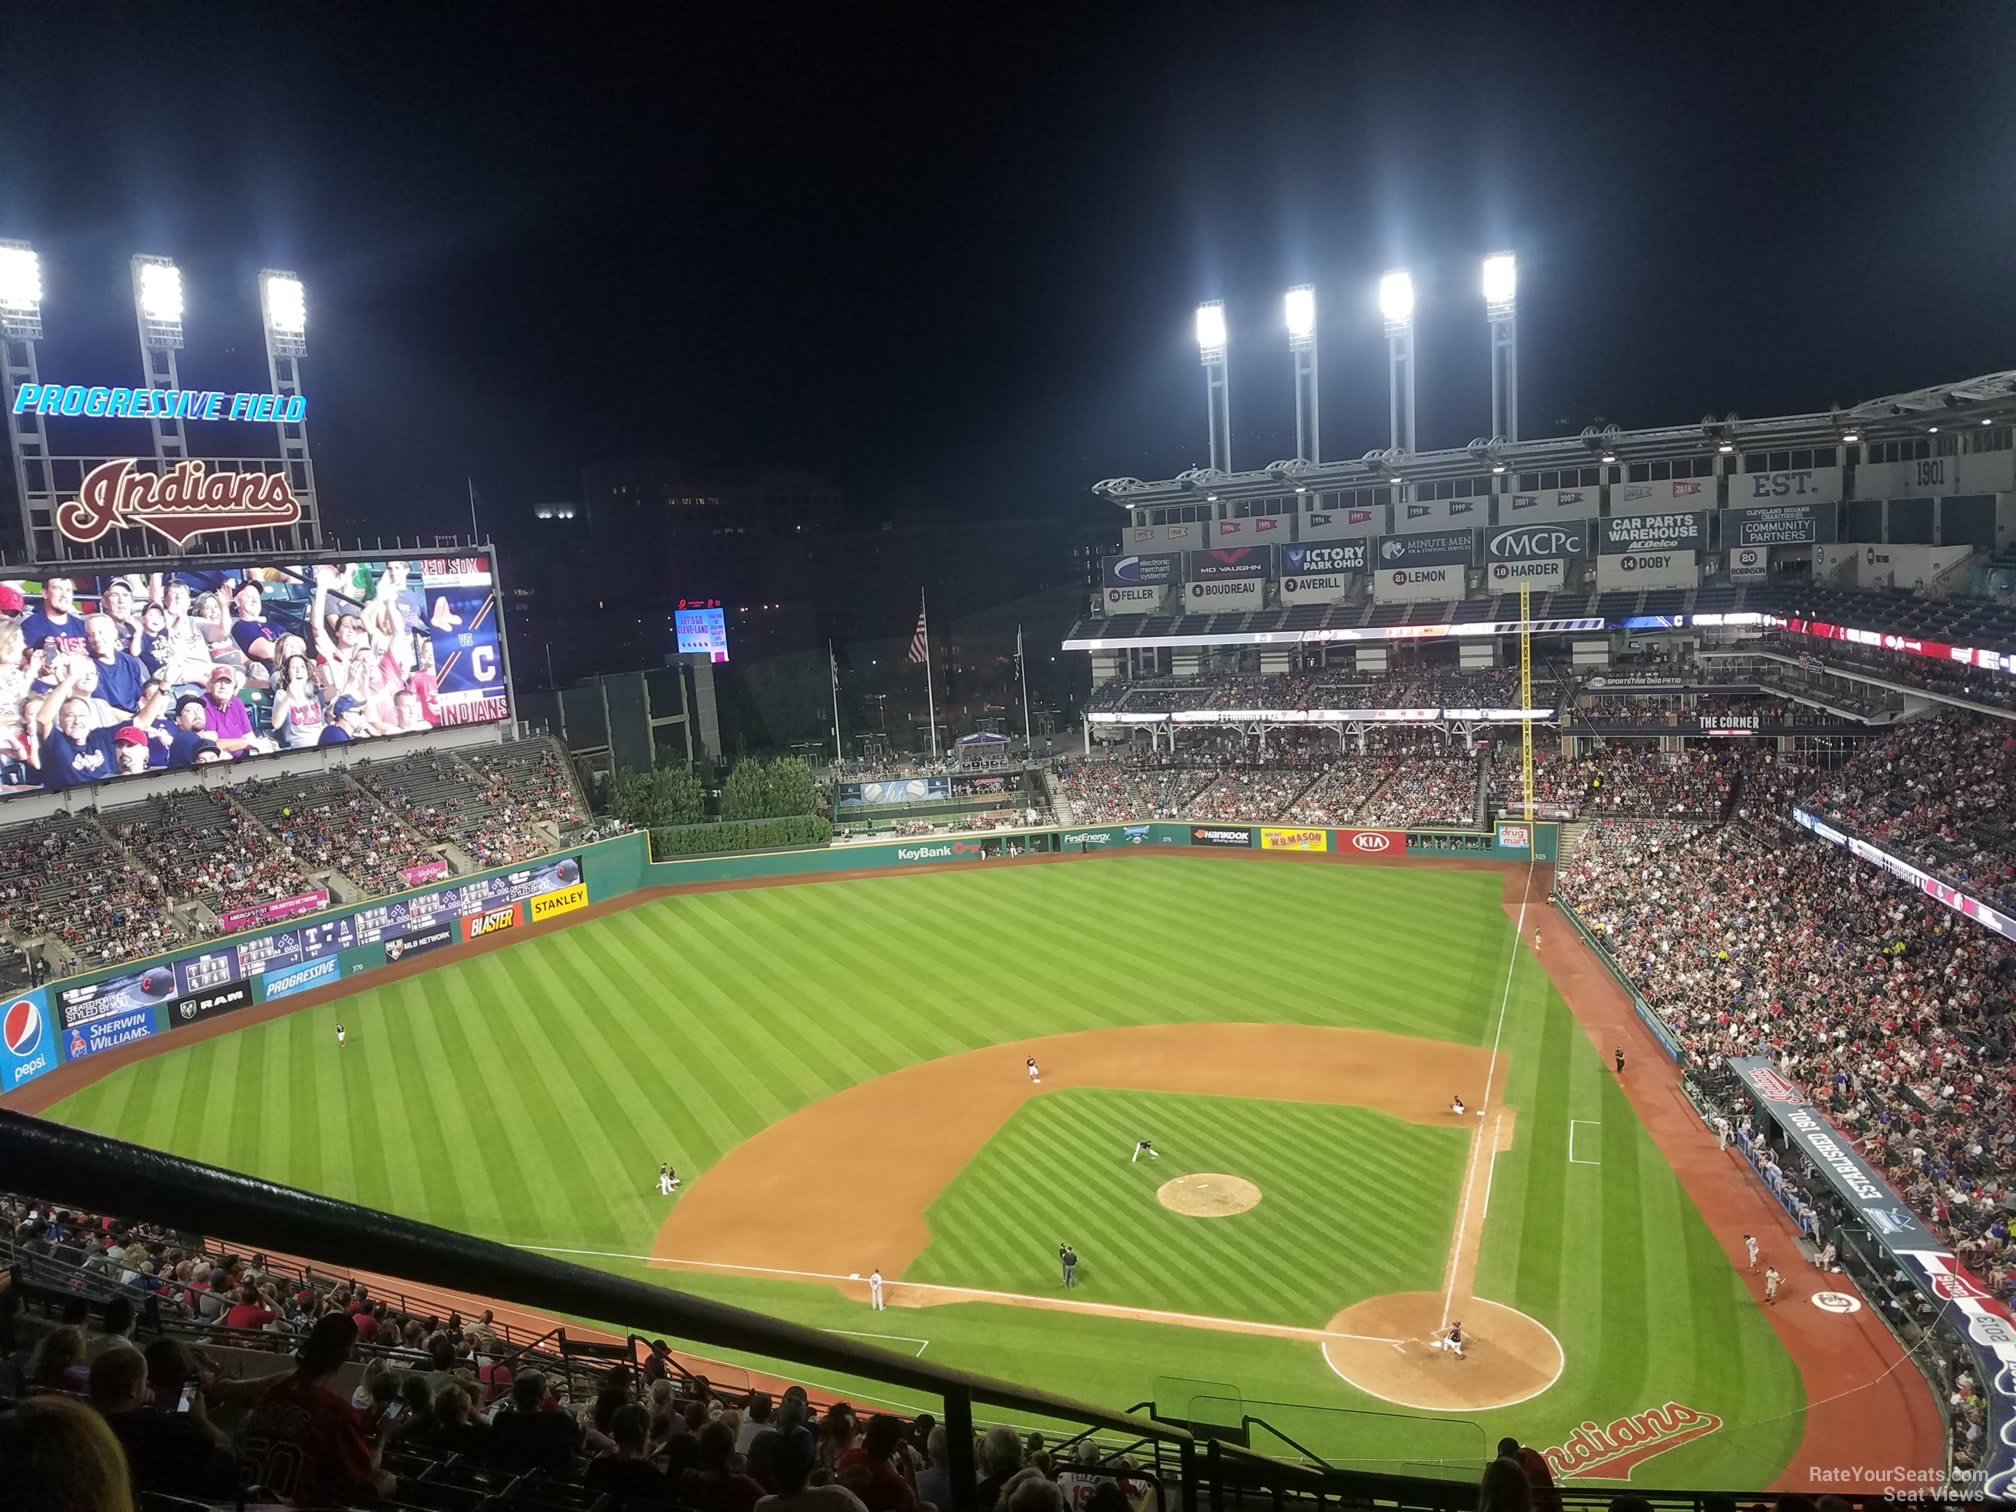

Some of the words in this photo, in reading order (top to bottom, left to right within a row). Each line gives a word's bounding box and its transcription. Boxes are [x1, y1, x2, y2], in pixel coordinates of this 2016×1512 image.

[13, 383, 224, 421] PROGRESSIVE
[229, 392, 307, 422] FIELD
[1917, 459, 1944, 486] 1901
[1752, 471, 1818, 498] EST.
[56, 458, 301, 546] Indians
[1560, 494, 1575, 503] 2007
[1452, 503, 1465, 511] 1999
[1351, 512, 1364, 521] 1997
[1612, 518, 1641, 530] CAR
[1646, 514, 1694, 527] PARTS
[1745, 520, 1810, 533] COMMUNITY
[1609, 526, 1698, 542] WAREHOUSE
[1750, 530, 1806, 542] PARTNERS
[1407, 538, 1446, 550] MINUTE
[1448, 536, 1471, 546] MEN
[1139, 558, 1170, 566] electronic
[1303, 560, 1332, 570] PARK
[1333, 558, 1364, 568] OHIO
[1622, 559, 1634, 568] 14
[1639, 556, 1671, 569] DOBY
[1741, 553, 1755, 562] 20
[449, 557, 479, 575] SOX
[1140, 565, 1170, 573] merchant
[1219, 564, 1261, 572] VAUGHN
[1511, 562, 1558, 577] HARDER
[1731, 567, 1766, 575] ROBINSON
[1395, 574, 1405, 582] 21
[1408, 570, 1445, 583] LEMON
[1195, 587, 1201, 595] 5
[1205, 583, 1255, 596] BOUDREAU
[1288, 581, 1294, 589] 3
[1299, 577, 1340, 590] AVERILL
[1121, 589, 1153, 600] FELLER
[458, 633, 474, 647] VS
[472, 645, 496, 682] C
[1607, 677, 1646, 685] SPORTSTIME
[440, 698, 508, 727] INDIANS
[1699, 717, 1717, 728] THE
[1719, 716, 1760, 729] CORNER
[1501, 826, 1523, 838] drug
[1359, 836, 1383, 848] KIA
[898, 845, 951, 860] KeyBank
[269, 901, 295, 911] UNLIMITED
[535, 891, 584, 914] STANLEY
[470, 908, 514, 937] BLASTER
[404, 940, 418, 950] MLB
[418, 931, 451, 946] NETWORK
[352, 963, 363, 973] 370
[142, 977, 152, 990] C
[266, 958, 337, 997] PROGRESSIVE
[200, 991, 244, 1011] RAM
[66, 1006, 98, 1023] STYLED
[99, 1003, 110, 1014] BY
[90, 1013, 146, 1038] SHERWIN
[14, 1053, 47, 1082] pepsi
[1807, 1132, 1884, 1200] ESTABLISHED
[1537, 1401, 1724, 1481] ndians
